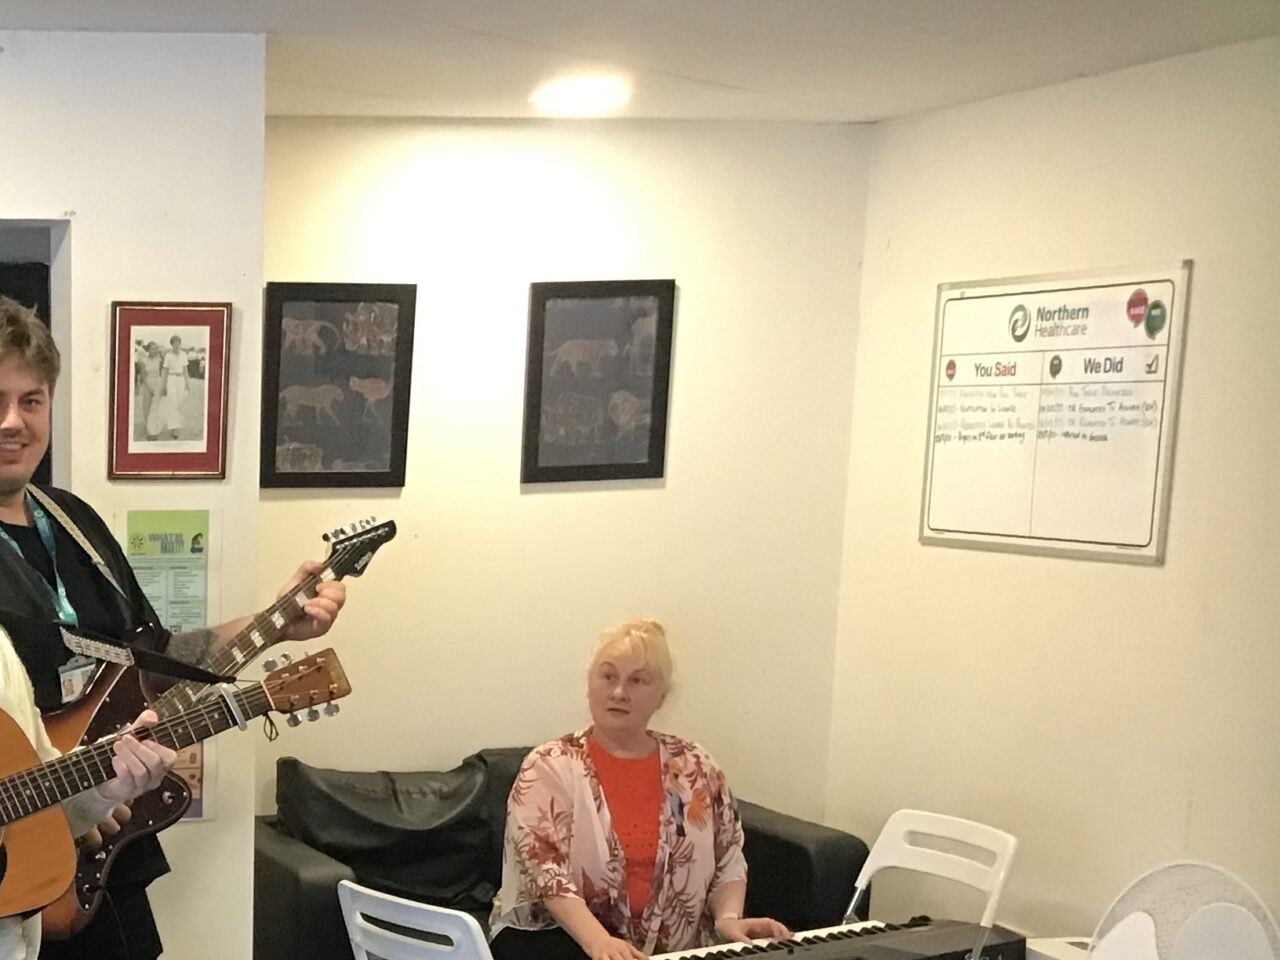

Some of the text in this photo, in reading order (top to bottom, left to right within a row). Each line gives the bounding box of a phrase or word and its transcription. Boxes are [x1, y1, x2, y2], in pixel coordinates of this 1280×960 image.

[1036, 305, 1089, 323] Northern
[1034, 321, 1088, 338] Healthcare
[974, 361, 1017, 378] You Said
[1083, 357, 1123, 374] We Did
